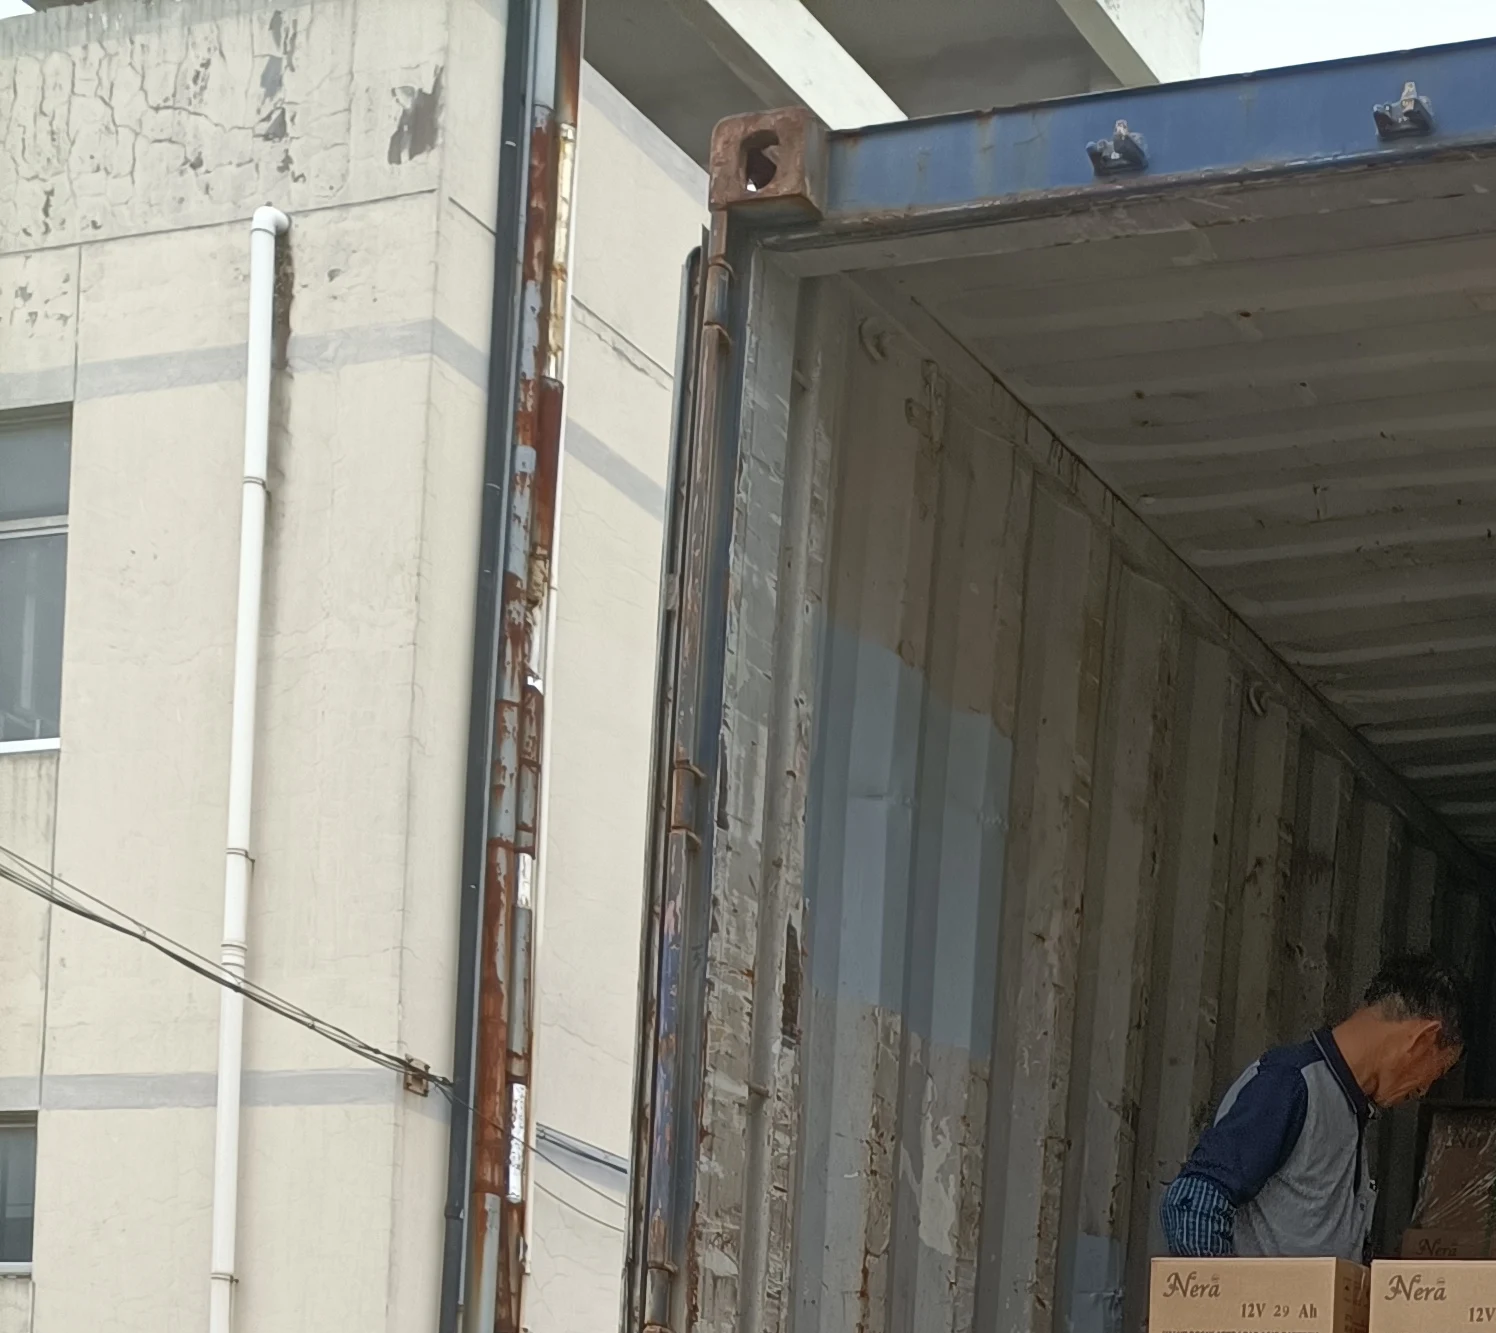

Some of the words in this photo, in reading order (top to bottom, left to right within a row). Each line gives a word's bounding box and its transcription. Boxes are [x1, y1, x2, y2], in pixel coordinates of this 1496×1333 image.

[1241, 1303, 1265, 1318] 12V
[1273, 1304, 1290, 1317] 29
[1299, 1304, 1318, 1318] Ah
[1469, 1307, 1496, 1322] 12V
